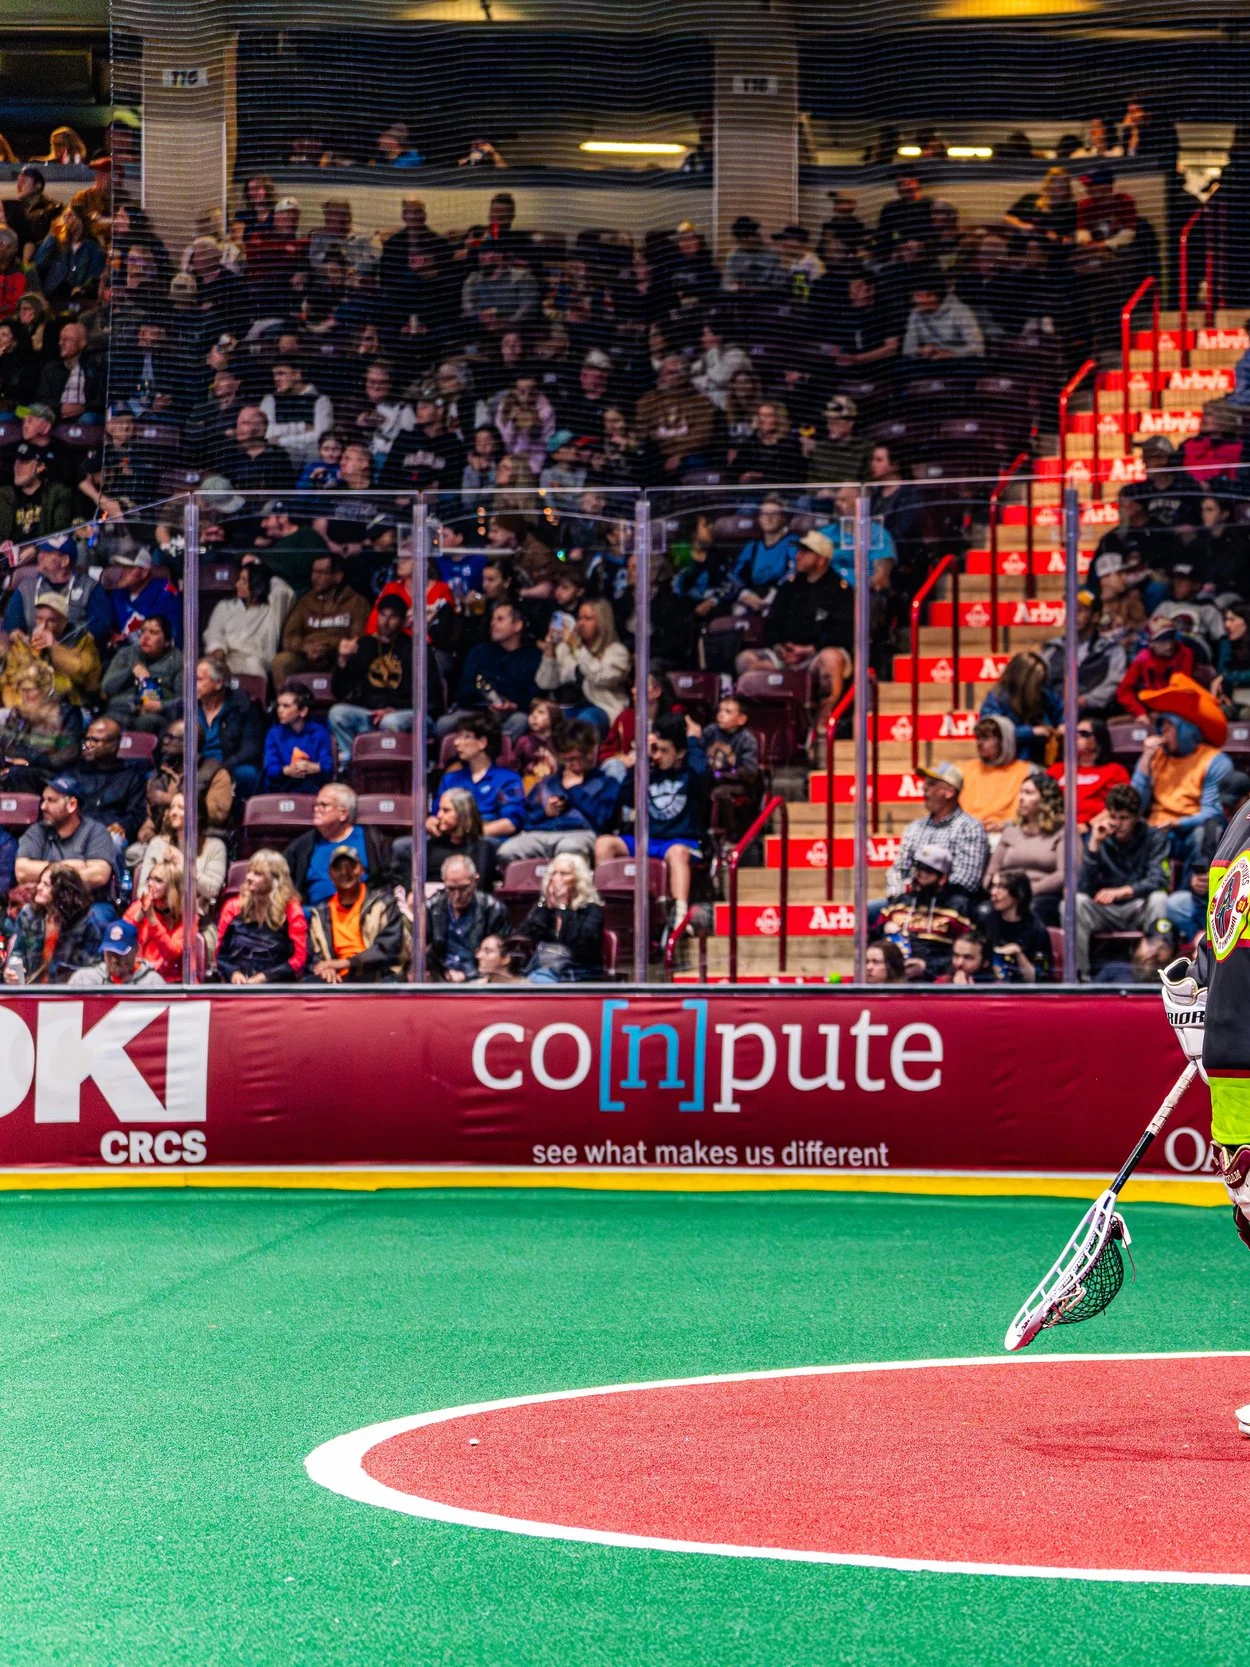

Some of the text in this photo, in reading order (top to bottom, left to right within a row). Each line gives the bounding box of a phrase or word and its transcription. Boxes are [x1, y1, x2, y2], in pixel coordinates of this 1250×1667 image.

[471, 999, 944, 1112] co[n]pute
[100, 1129, 207, 1165] CRCS
[532, 1140, 890, 1167] see what makes us different
